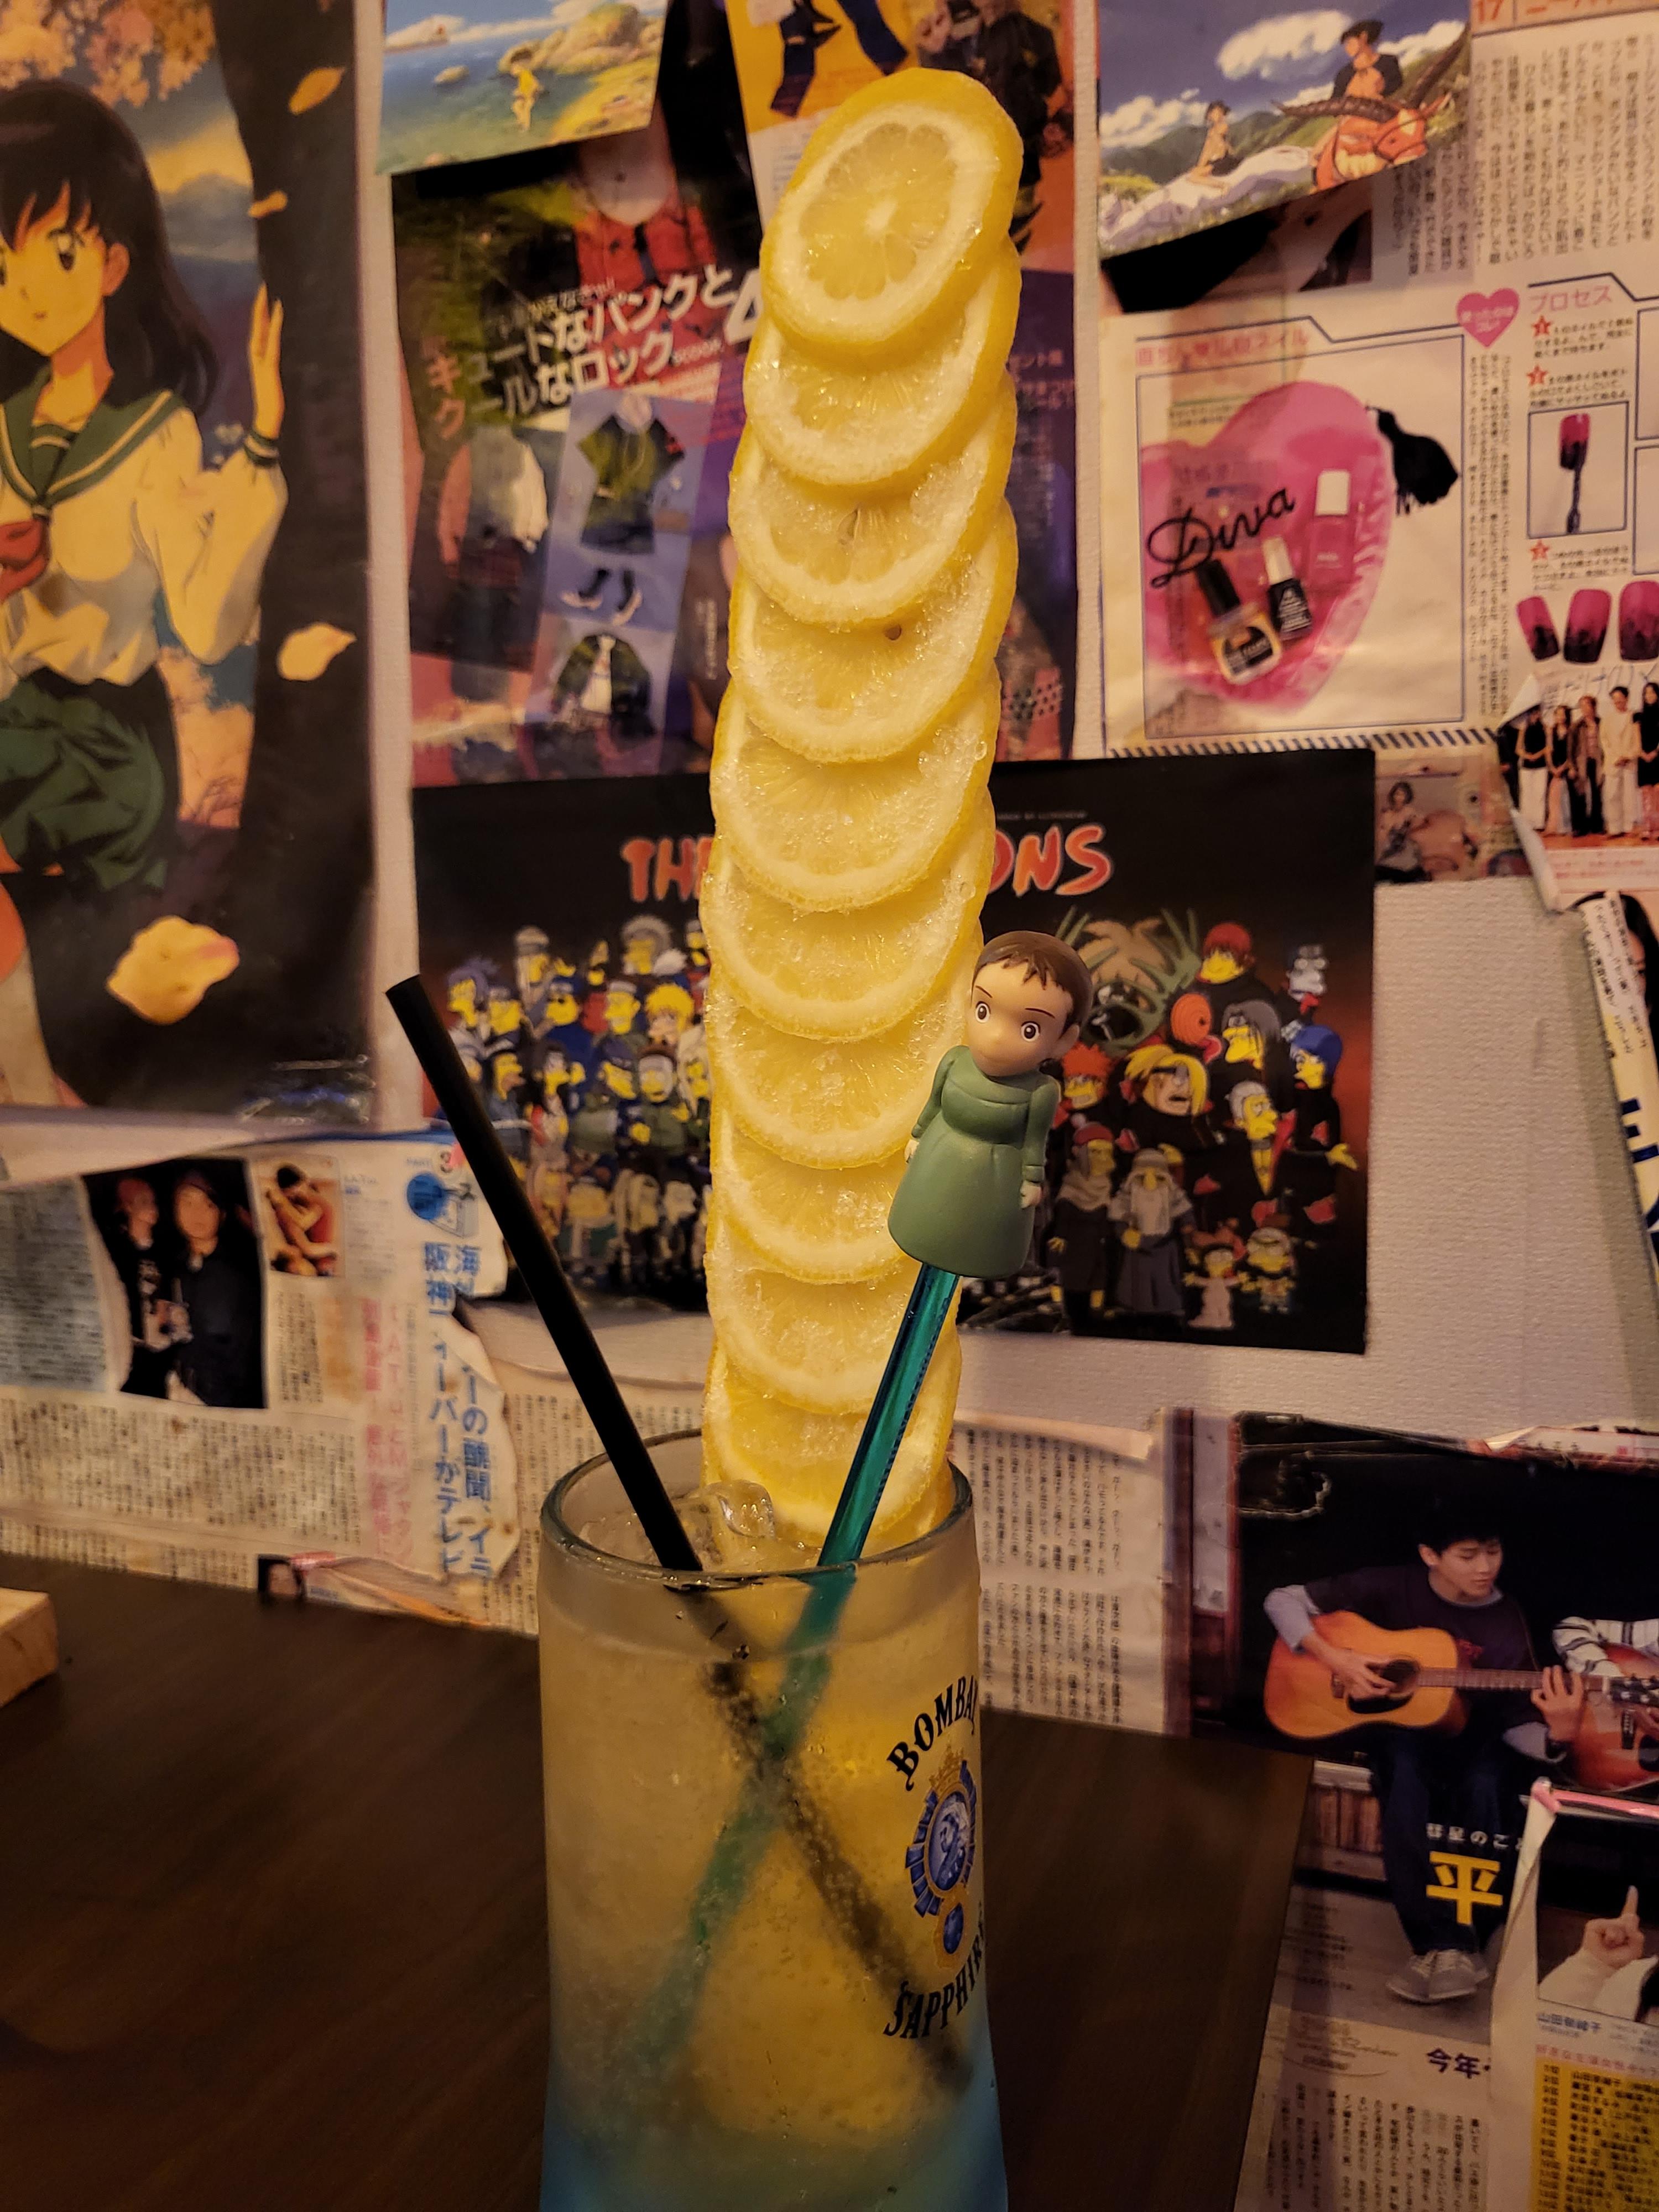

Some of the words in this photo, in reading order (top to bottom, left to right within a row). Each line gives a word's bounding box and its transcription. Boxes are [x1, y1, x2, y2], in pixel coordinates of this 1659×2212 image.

[1528, 284, 1613, 315] プロセス
[1147, 488, 1296, 588] Diva
[1425, 1850, 1504, 1925] 平
[1426, 2047, 1490, 2079] 今年
